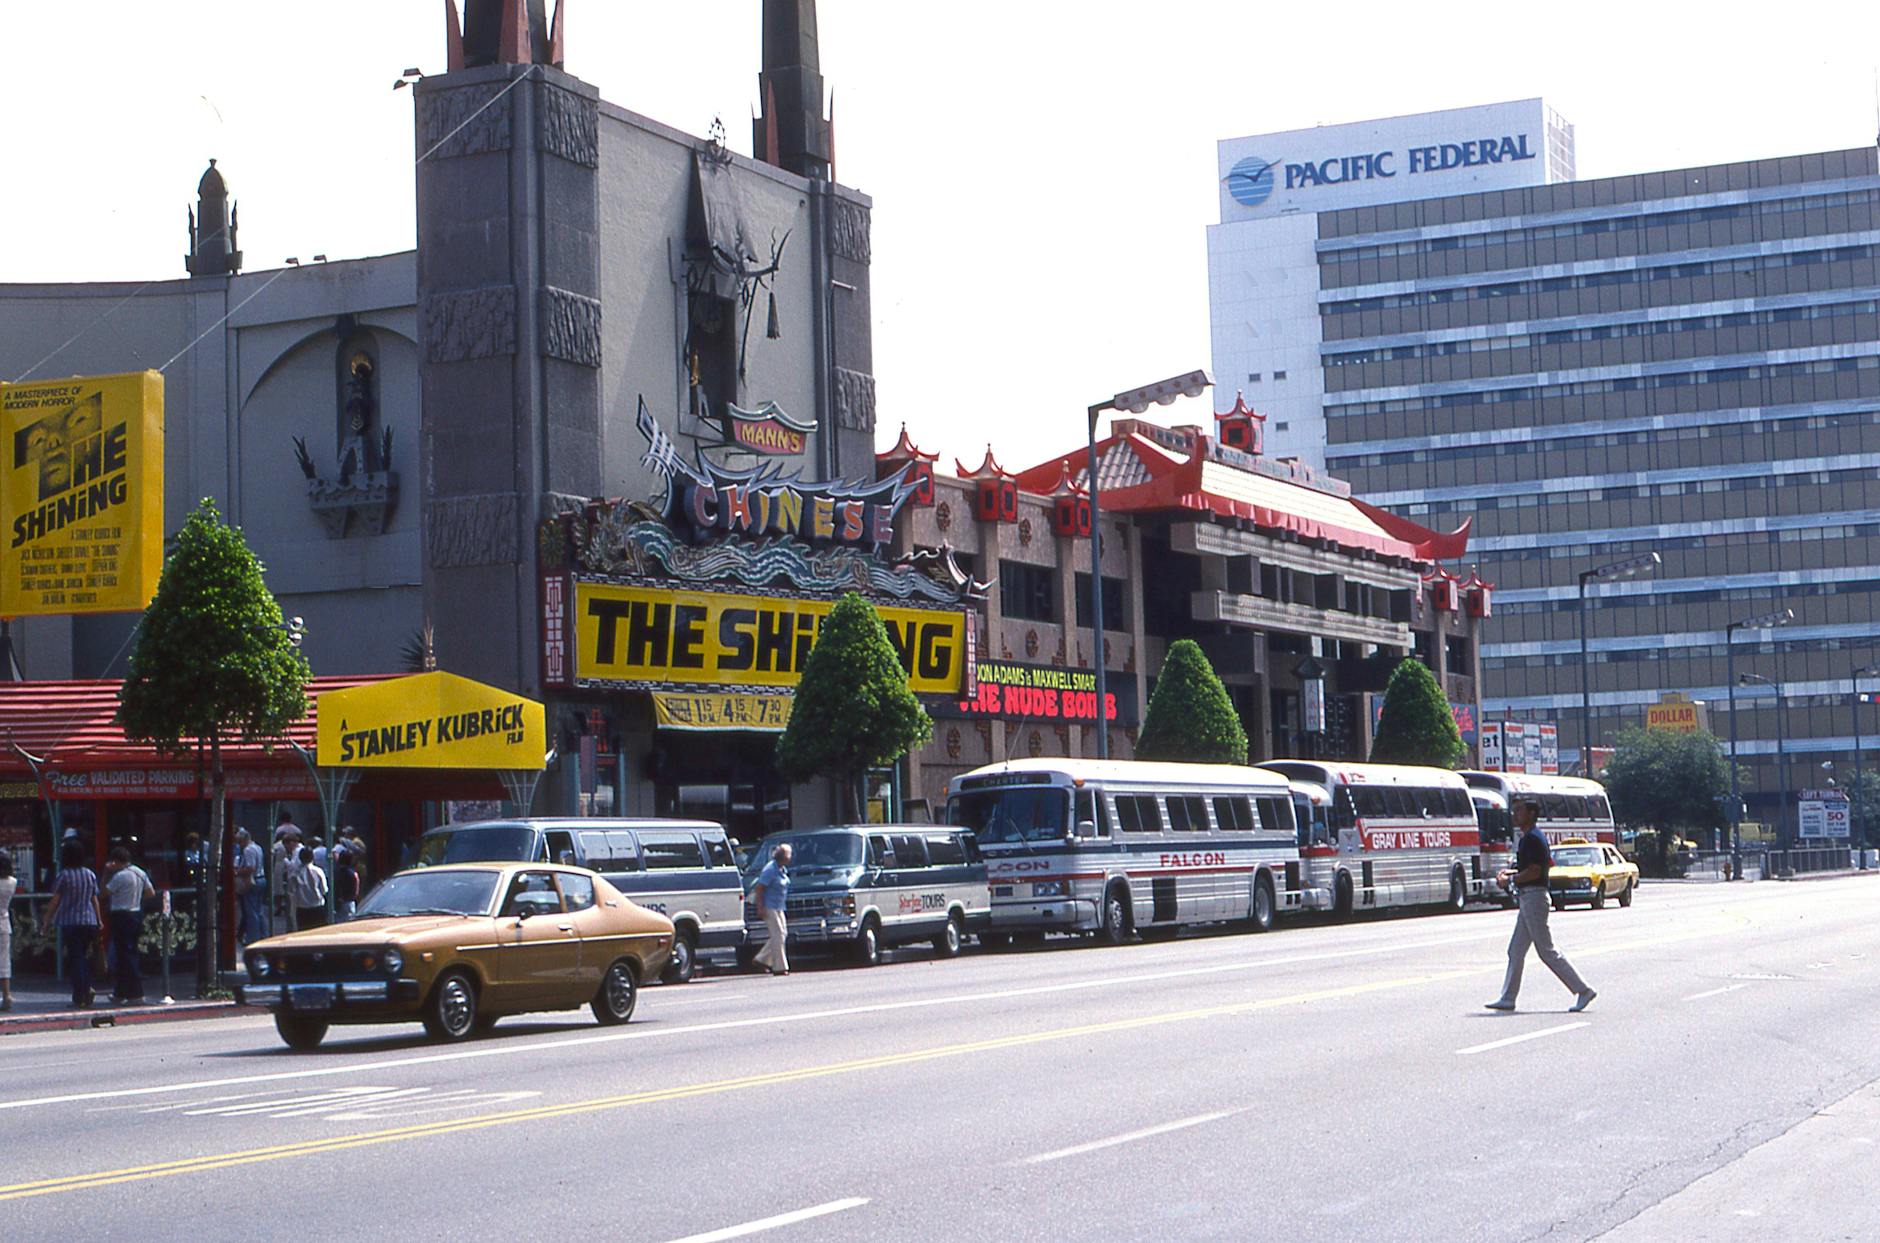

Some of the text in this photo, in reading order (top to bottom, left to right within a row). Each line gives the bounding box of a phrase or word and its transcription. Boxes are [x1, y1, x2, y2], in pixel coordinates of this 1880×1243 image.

[1285, 134, 1537, 190] PACIFIC FEDERAL
[14, 388, 68, 399] MASTERPIECE
[72, 386, 81, 396] OF
[4, 397, 75, 410] MODERN HORROR
[14, 391, 127, 502] THE
[741, 423, 801, 452] MANN'S
[693, 483, 894, 545] CHINESE
[588, 598, 708, 669] THE
[994, 666, 1025, 686] ADAMS
[1032, 669, 1072, 690] MAXWELL
[1073, 673, 1096, 691] SMAR
[1004, 686, 1059, 717] NUDE
[340, 718, 348, 731] A
[1650, 708, 1693, 724] DOLLAR
[340, 718, 432, 763] STANLEY
[45, 769, 88, 790] Free
[91, 770, 145, 785] VALIDATED
[149, 770, 195, 785] PARKING
[1827, 811, 1844, 821] 50
[1372, 831, 1451, 850] GRAY LINE TOURS
[986, 860, 1051, 873] LCON
[1160, 851, 1226, 868] FALCON
[921, 893, 946, 909] TOURS
